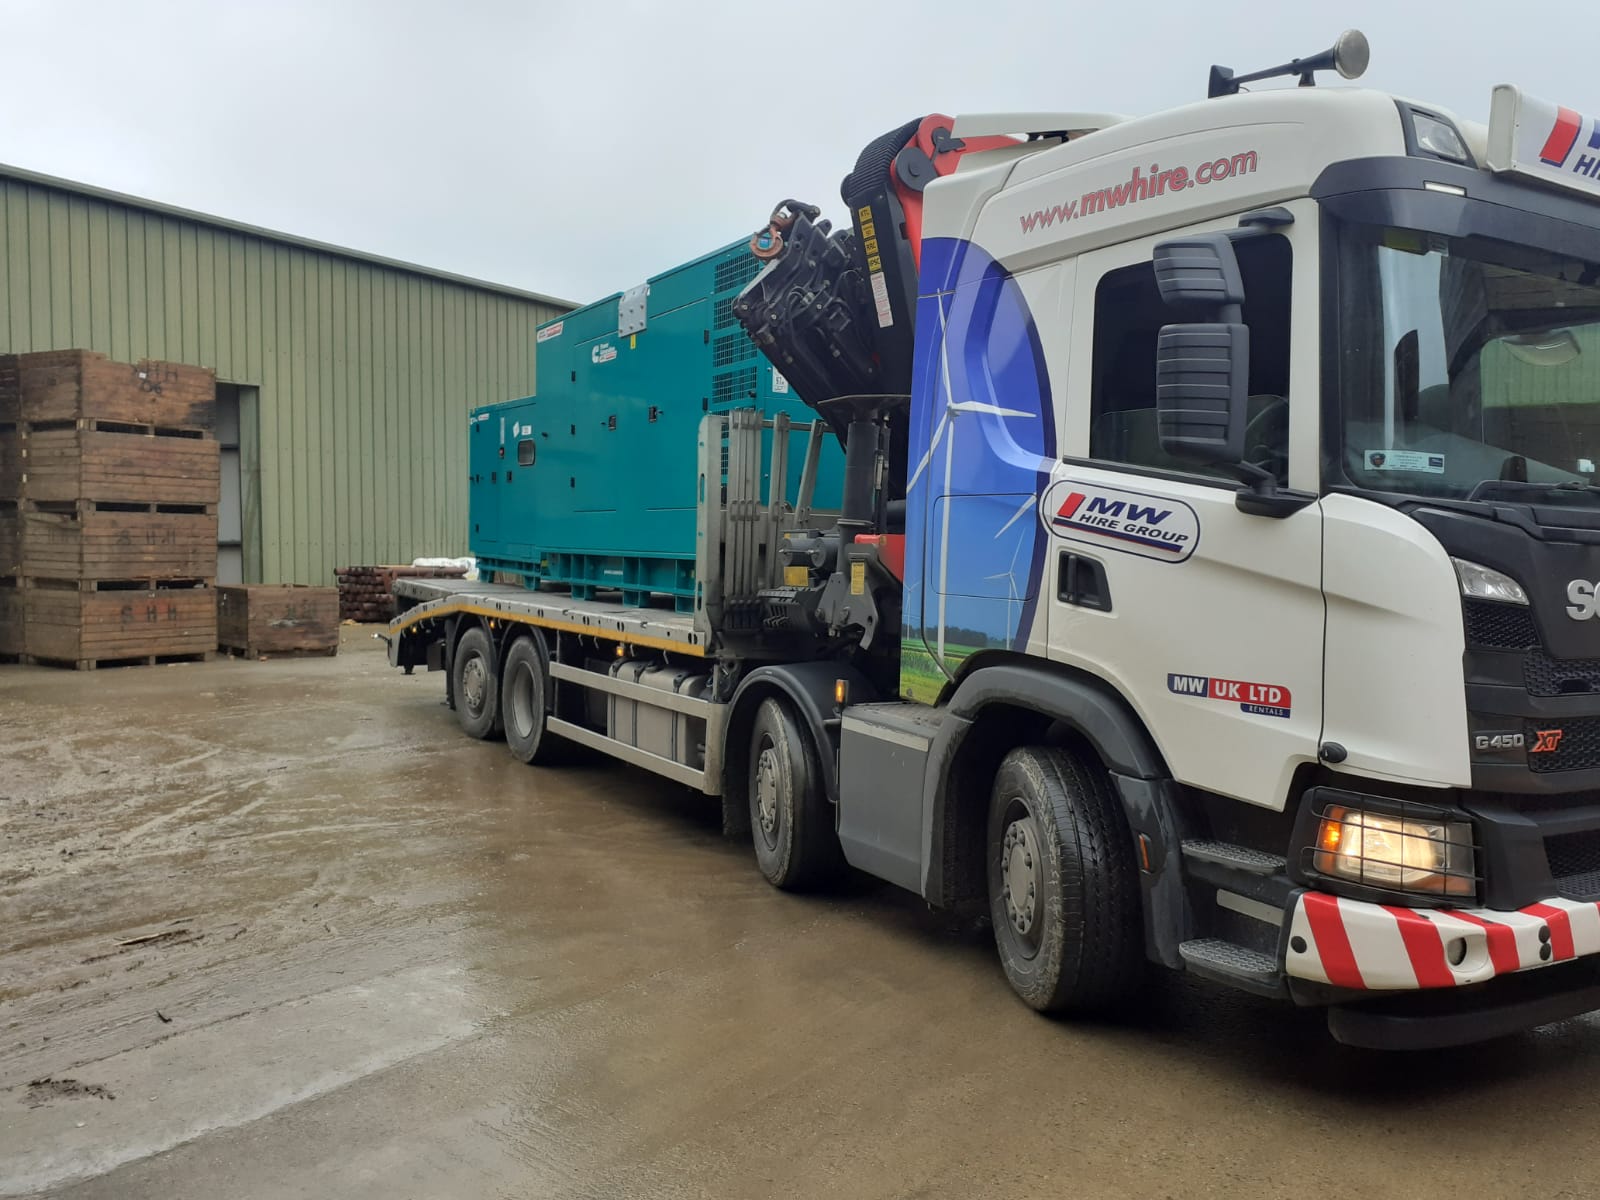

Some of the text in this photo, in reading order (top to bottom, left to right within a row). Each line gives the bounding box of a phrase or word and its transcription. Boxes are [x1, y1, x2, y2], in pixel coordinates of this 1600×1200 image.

[1020, 150, 1258, 234] www.mwhire.com
[1086, 497, 1172, 525] MW
[1080, 514, 1188, 543] HIRE GROUP
[1566, 578, 1600, 621] S
[1174, 676, 1281, 703] MW UK LTD
[1249, 705, 1283, 716] RENTALS
